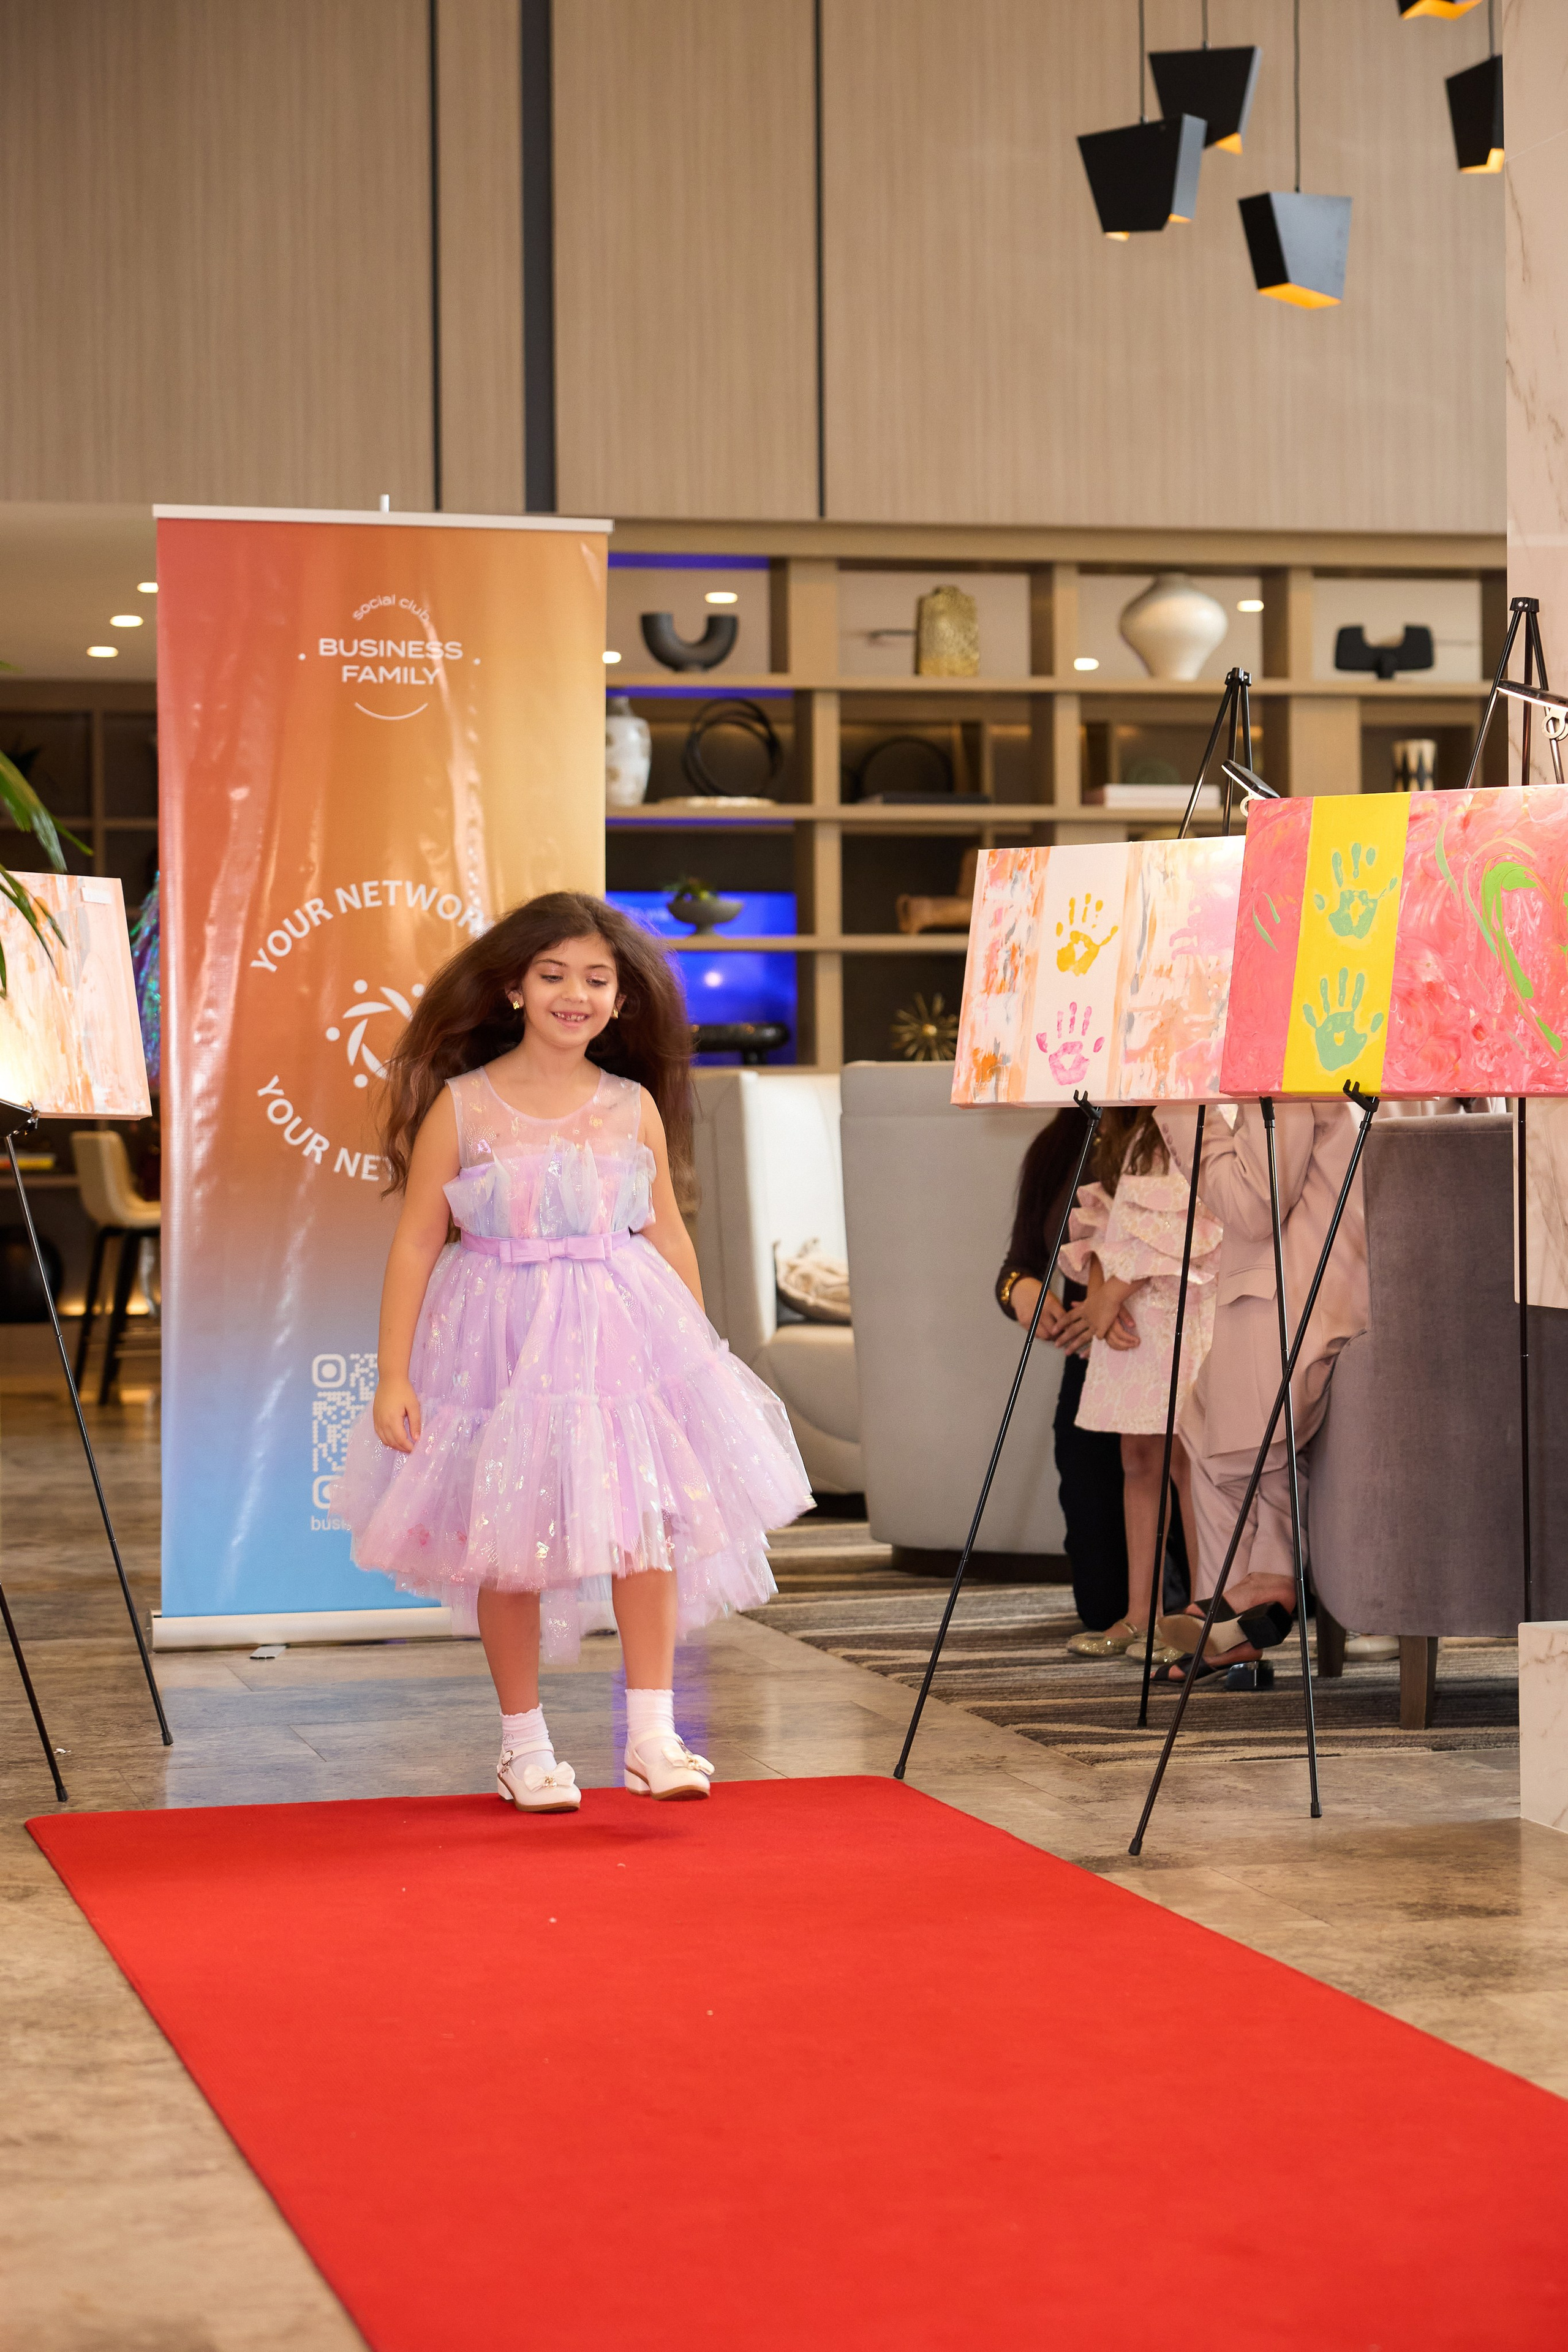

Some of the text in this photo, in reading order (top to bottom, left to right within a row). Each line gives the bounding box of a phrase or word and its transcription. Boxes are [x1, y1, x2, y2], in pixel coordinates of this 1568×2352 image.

[352, 594, 431, 624] social club
[318, 638, 464, 660] BUSINESS
[341, 665, 440, 685] FAMILY
[250, 897, 334, 973] YOUR
[257, 1075, 330, 1165] YOUR
